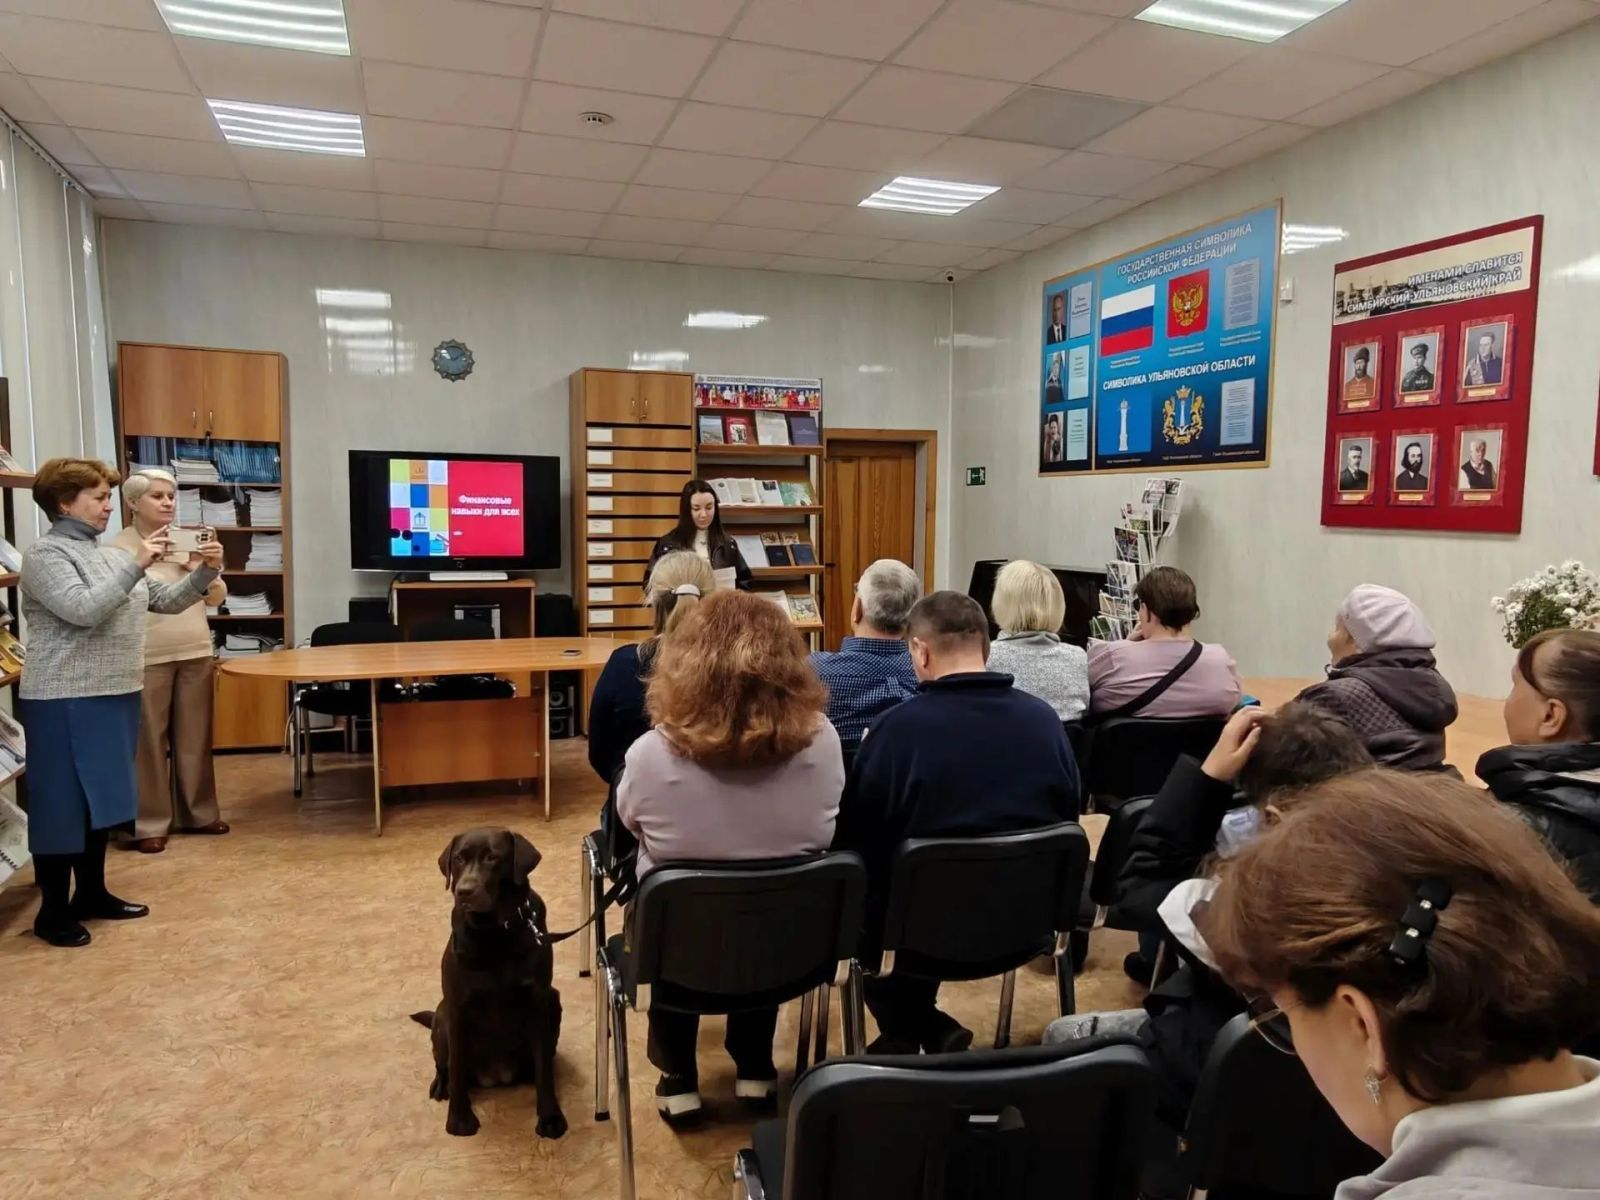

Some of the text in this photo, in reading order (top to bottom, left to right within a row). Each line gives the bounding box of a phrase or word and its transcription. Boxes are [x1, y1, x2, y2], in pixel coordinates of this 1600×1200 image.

[1117, 223, 1252, 275] ГОСУДАРСТВЕННАЯ СИМВОЛИКА
[1182, 243, 1237, 268] ФЕДЕРАЦИИ
[1408, 251, 1523, 287] ИМЕНАМИ СЛАВИТСЯ
[1492, 267, 1522, 285] КРАЙ
[1103, 374, 1147, 391] СИМВОЛИКА
[1149, 361, 1210, 382] УЛЬЯНОВСКОЙ
[1211, 355, 1256, 373] ОБЛАСТИ
[459, 495, 512, 504] Финансовые
[451, 508, 520, 517] навыки для всех
